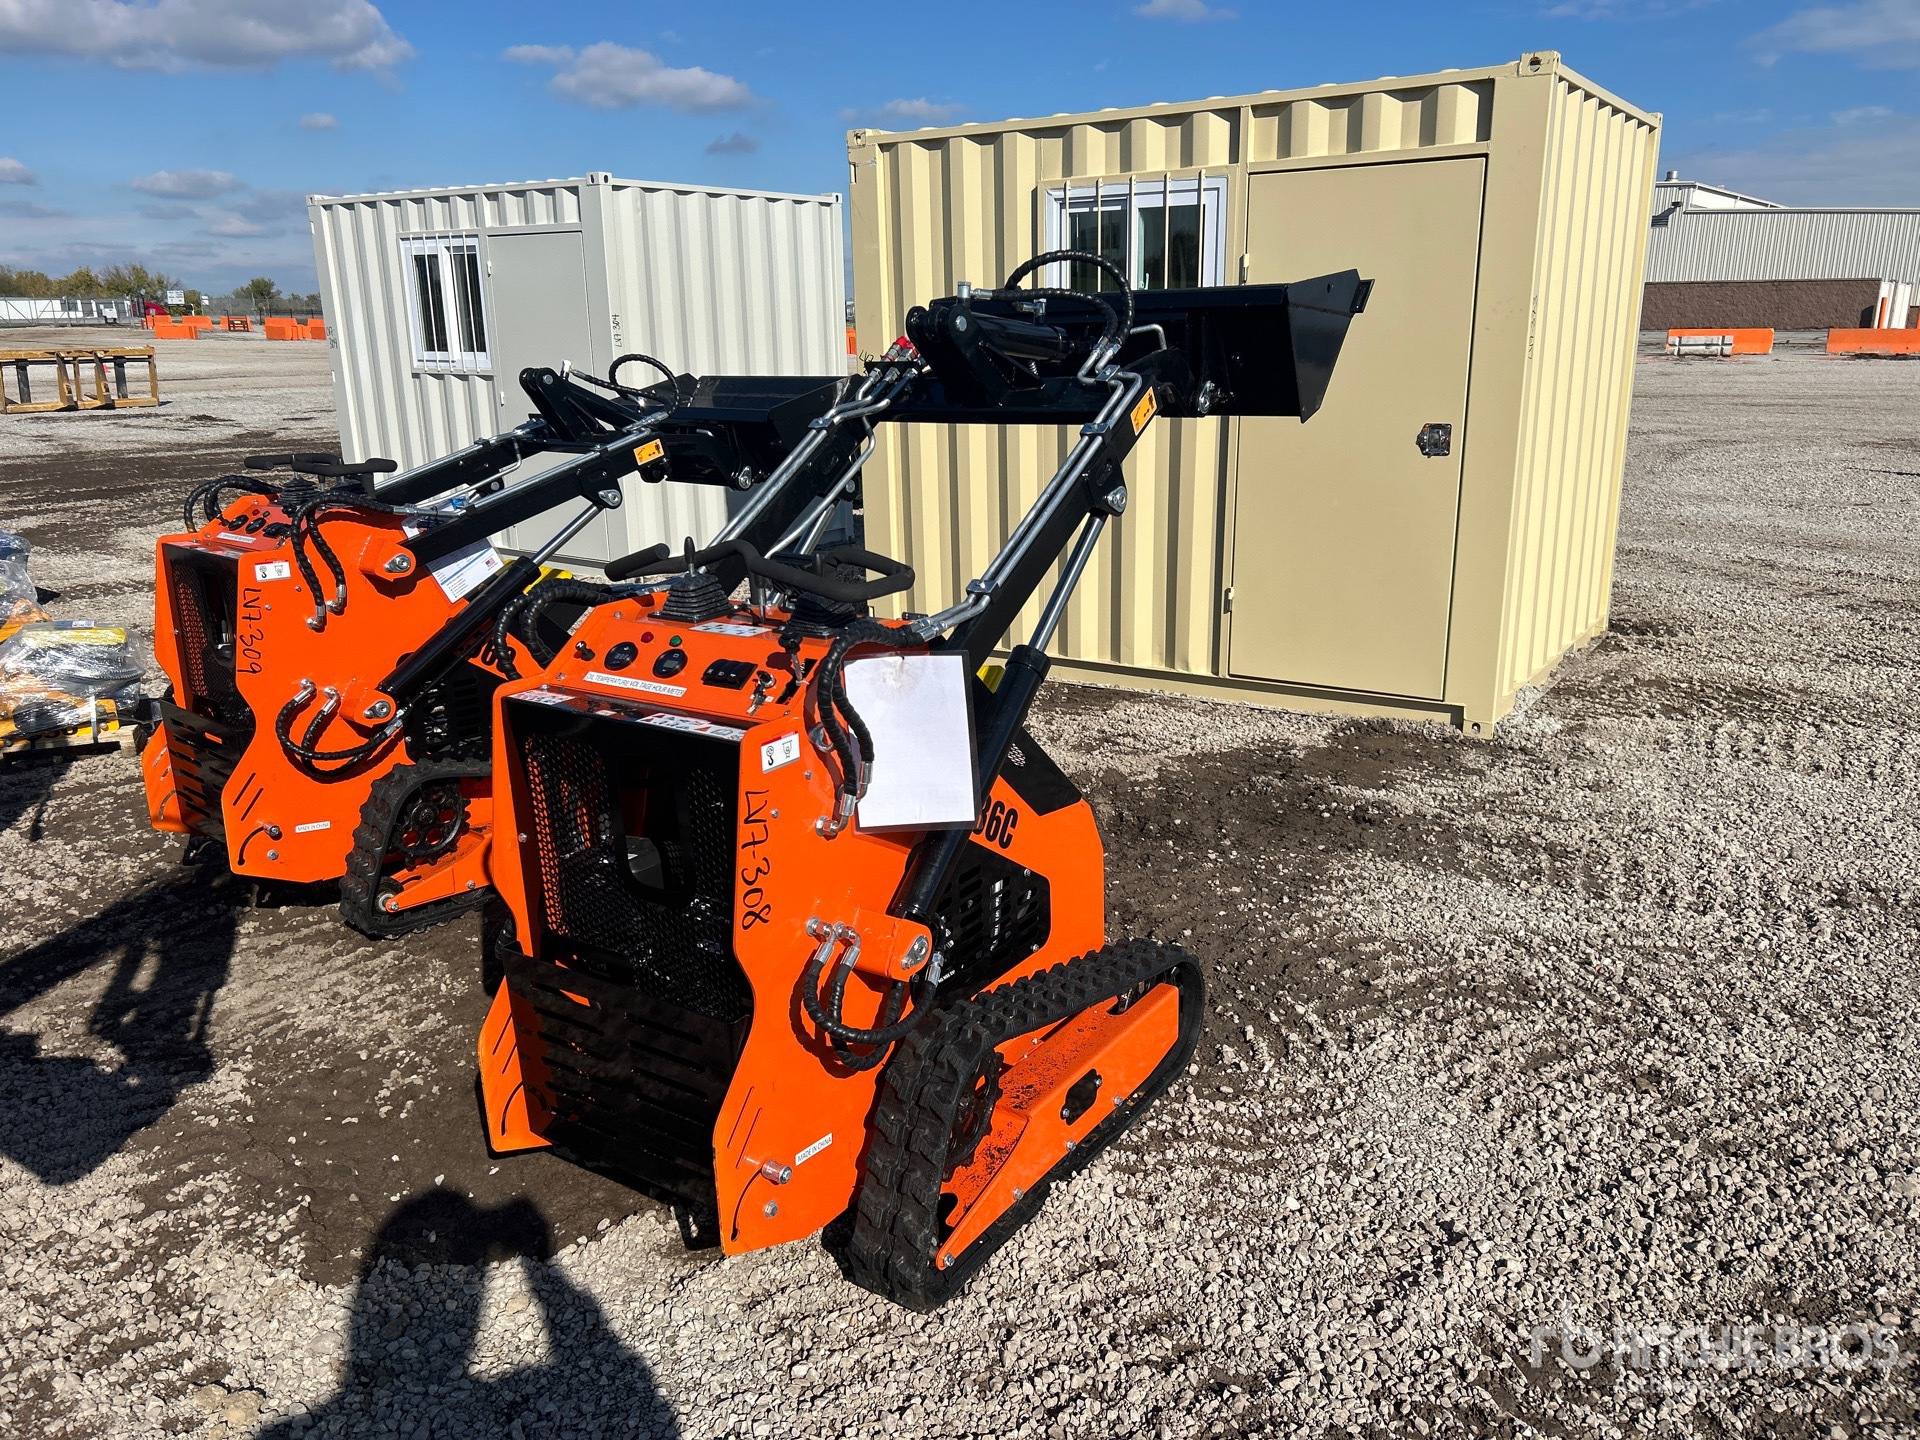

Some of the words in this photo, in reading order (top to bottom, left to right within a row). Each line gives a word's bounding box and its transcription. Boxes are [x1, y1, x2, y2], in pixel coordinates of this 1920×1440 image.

[237, 587, 264, 674] LV7-309
[595, 674, 630, 686] TEMPERATURE
[653, 684, 668, 692] HOUR
[667, 686, 684, 695] METER
[741, 789, 772, 931] LV7-308
[797, 1148, 811, 1162] MADE
[817, 1136, 831, 1150] CHINA
